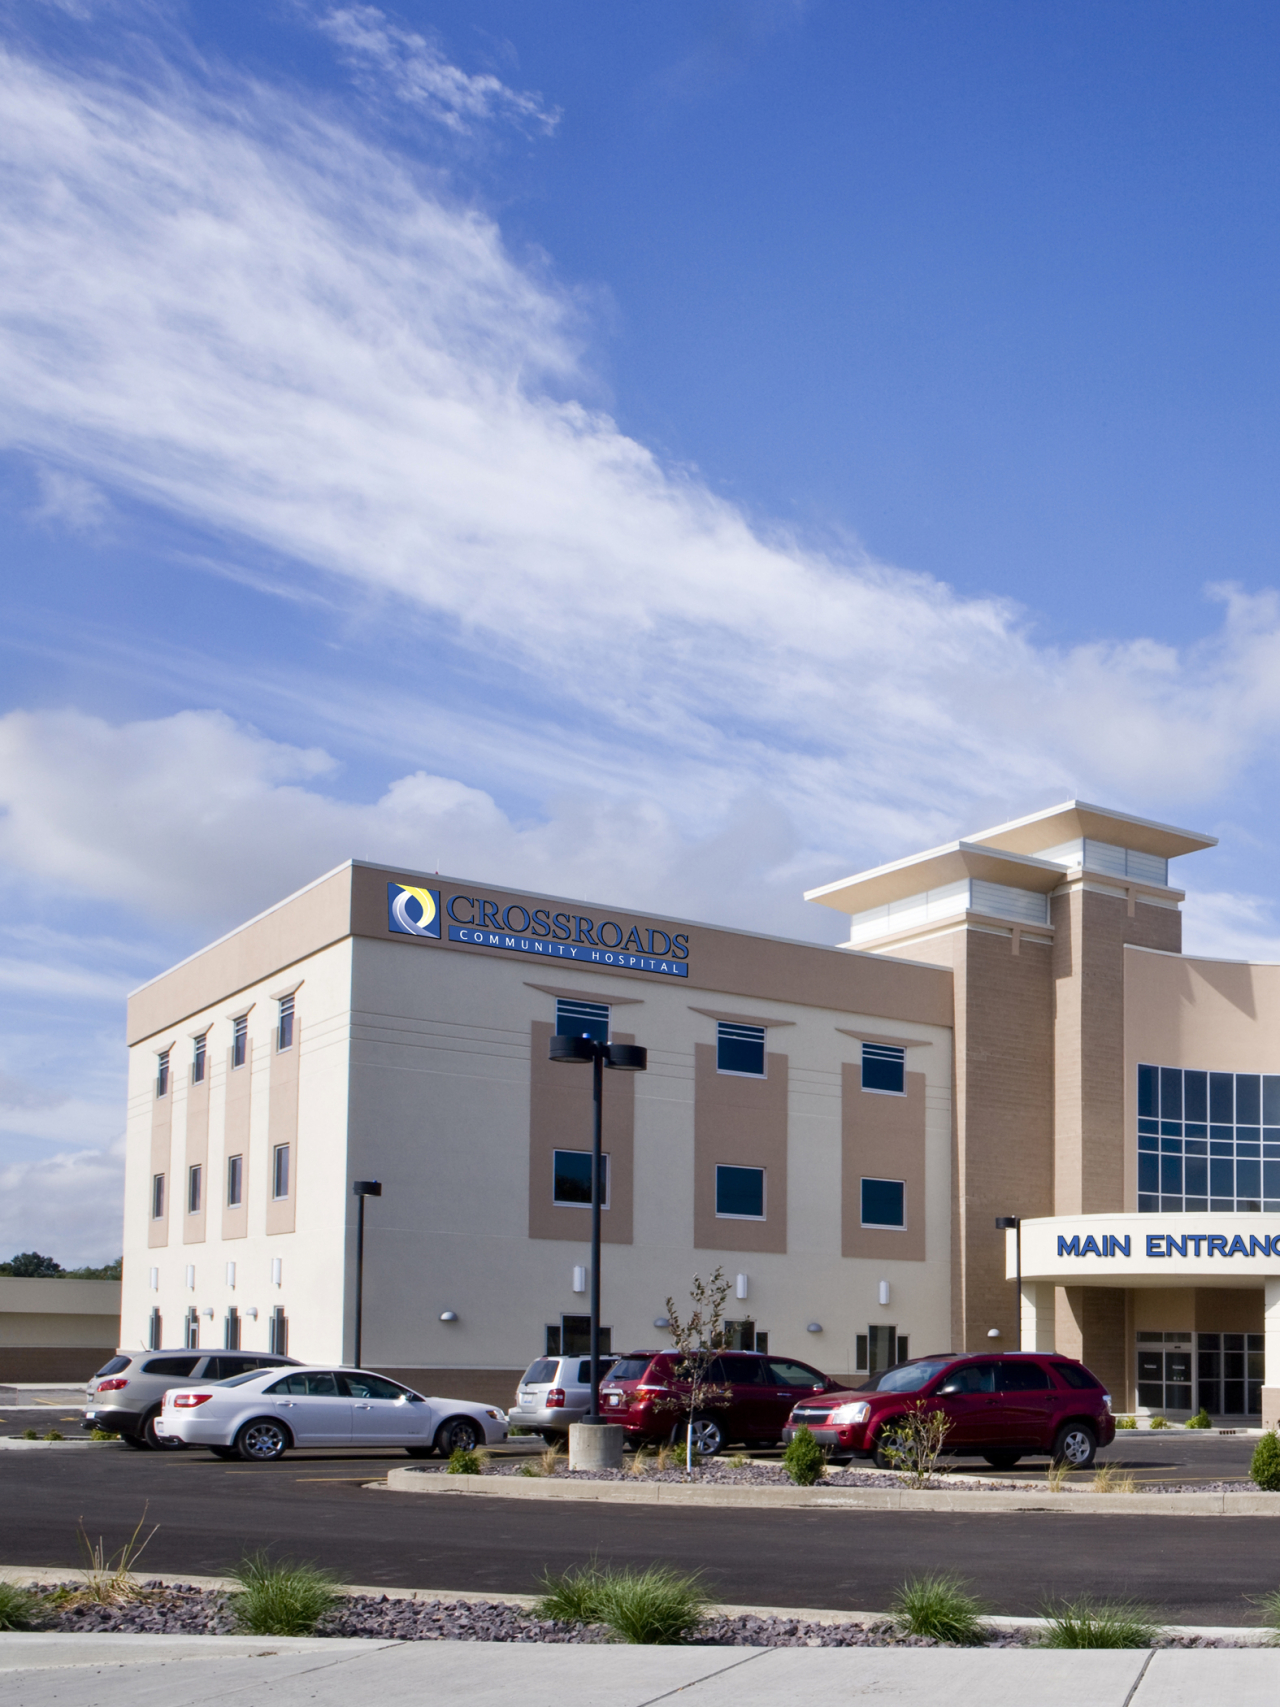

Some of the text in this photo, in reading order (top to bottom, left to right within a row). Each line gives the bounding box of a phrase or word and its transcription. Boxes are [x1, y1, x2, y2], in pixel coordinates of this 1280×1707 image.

[446, 894, 689, 959] CROSSROADS
[459, 930, 679, 974] COMMUNITY HOSPITAL
[1057, 1234, 1131, 1257] MAIN
